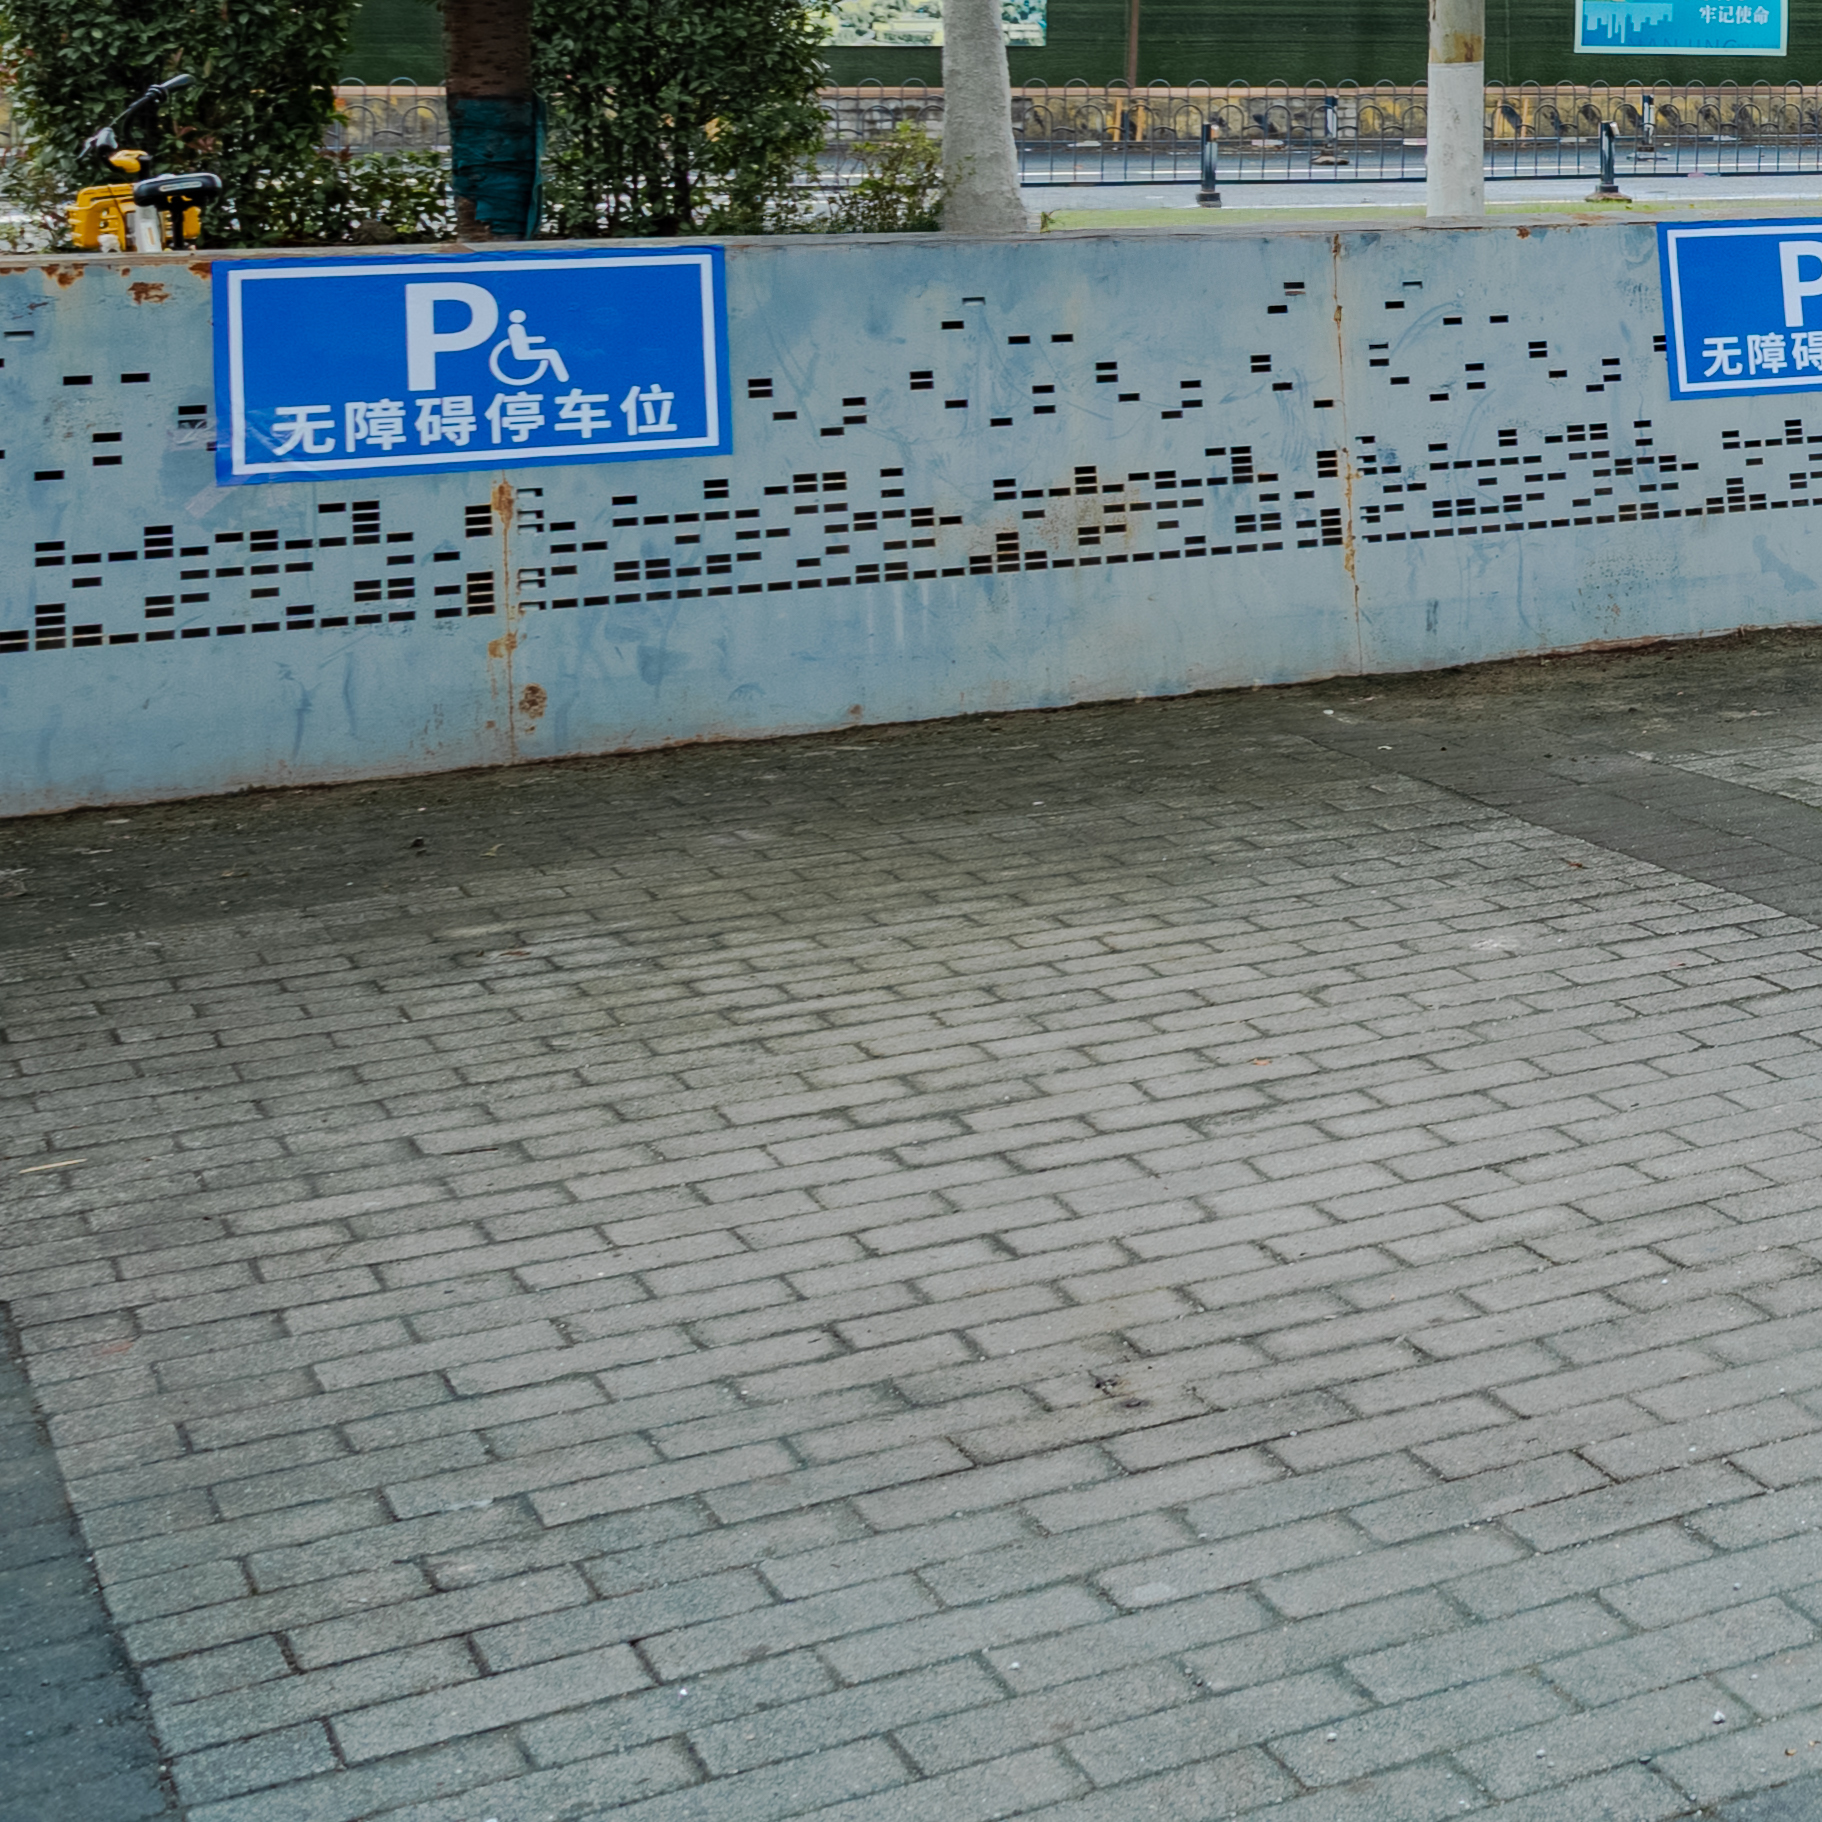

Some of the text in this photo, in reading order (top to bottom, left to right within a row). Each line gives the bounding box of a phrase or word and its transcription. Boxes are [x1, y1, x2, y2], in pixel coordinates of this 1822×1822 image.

[1699, 5, 1770, 25] 牢记使命
[405, 282, 499, 391] P
[272, 383, 678, 457] 无障碍停车位
